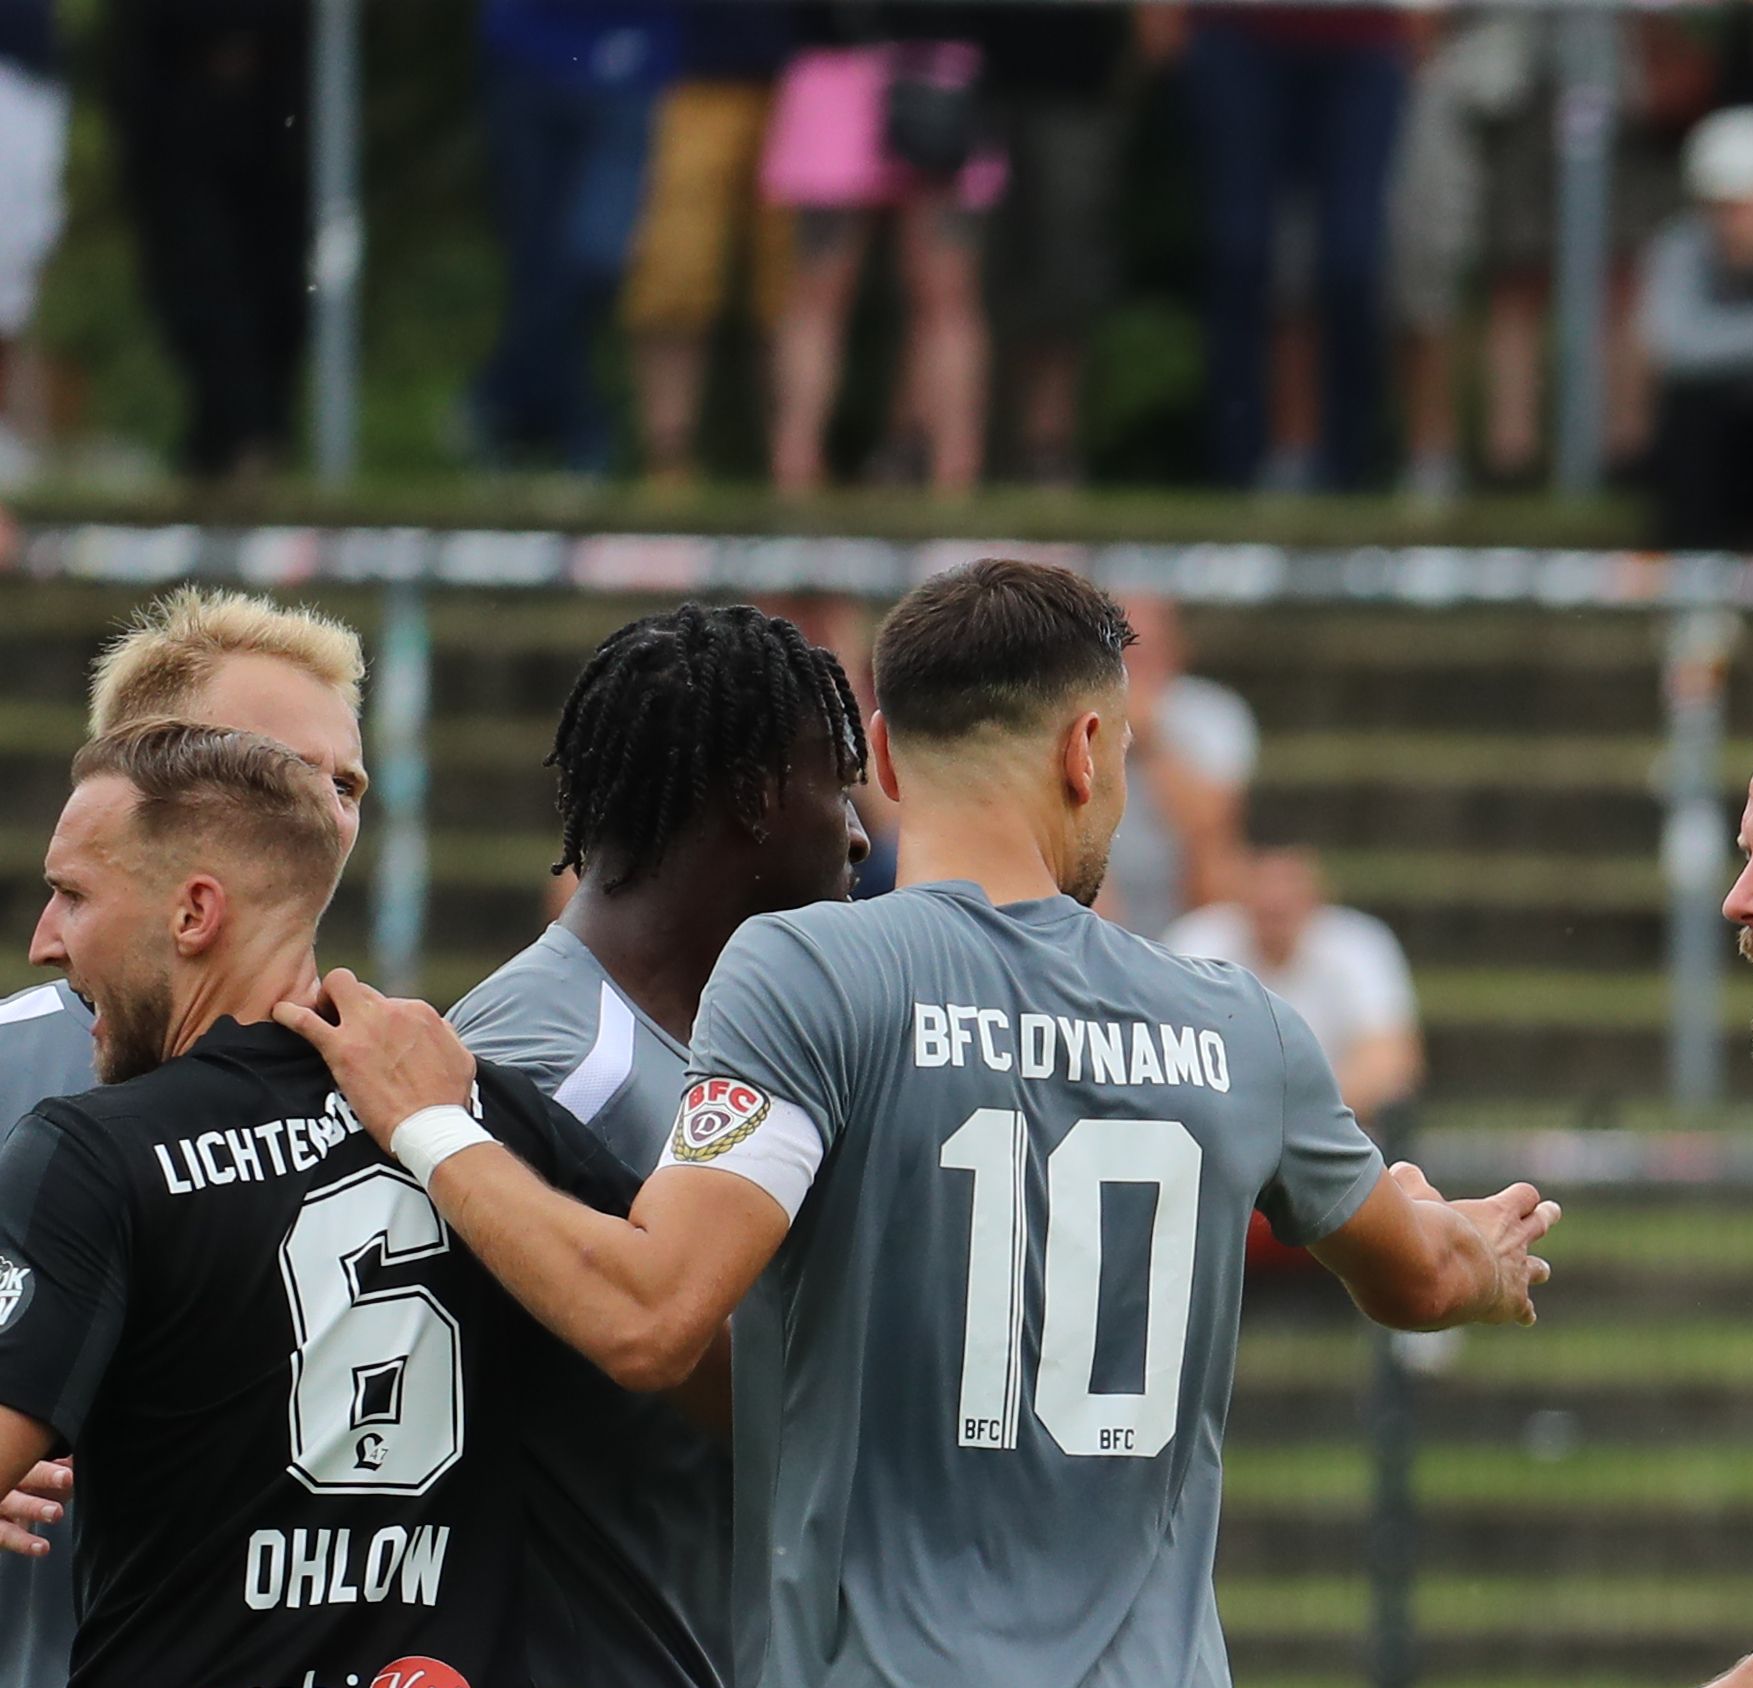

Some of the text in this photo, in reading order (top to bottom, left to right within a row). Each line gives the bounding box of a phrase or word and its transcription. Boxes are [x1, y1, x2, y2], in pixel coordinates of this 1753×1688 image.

[914, 1002, 1230, 1093] BFC DYNAMO
[688, 1080, 758, 1114] BFC
[940, 1108, 1202, 1457] 10
[279, 1162, 465, 1497] 6
[964, 1418, 1000, 1442] BFC
[1100, 1428, 1135, 1450] BFC
[244, 1524, 450, 1610] OHLOW
